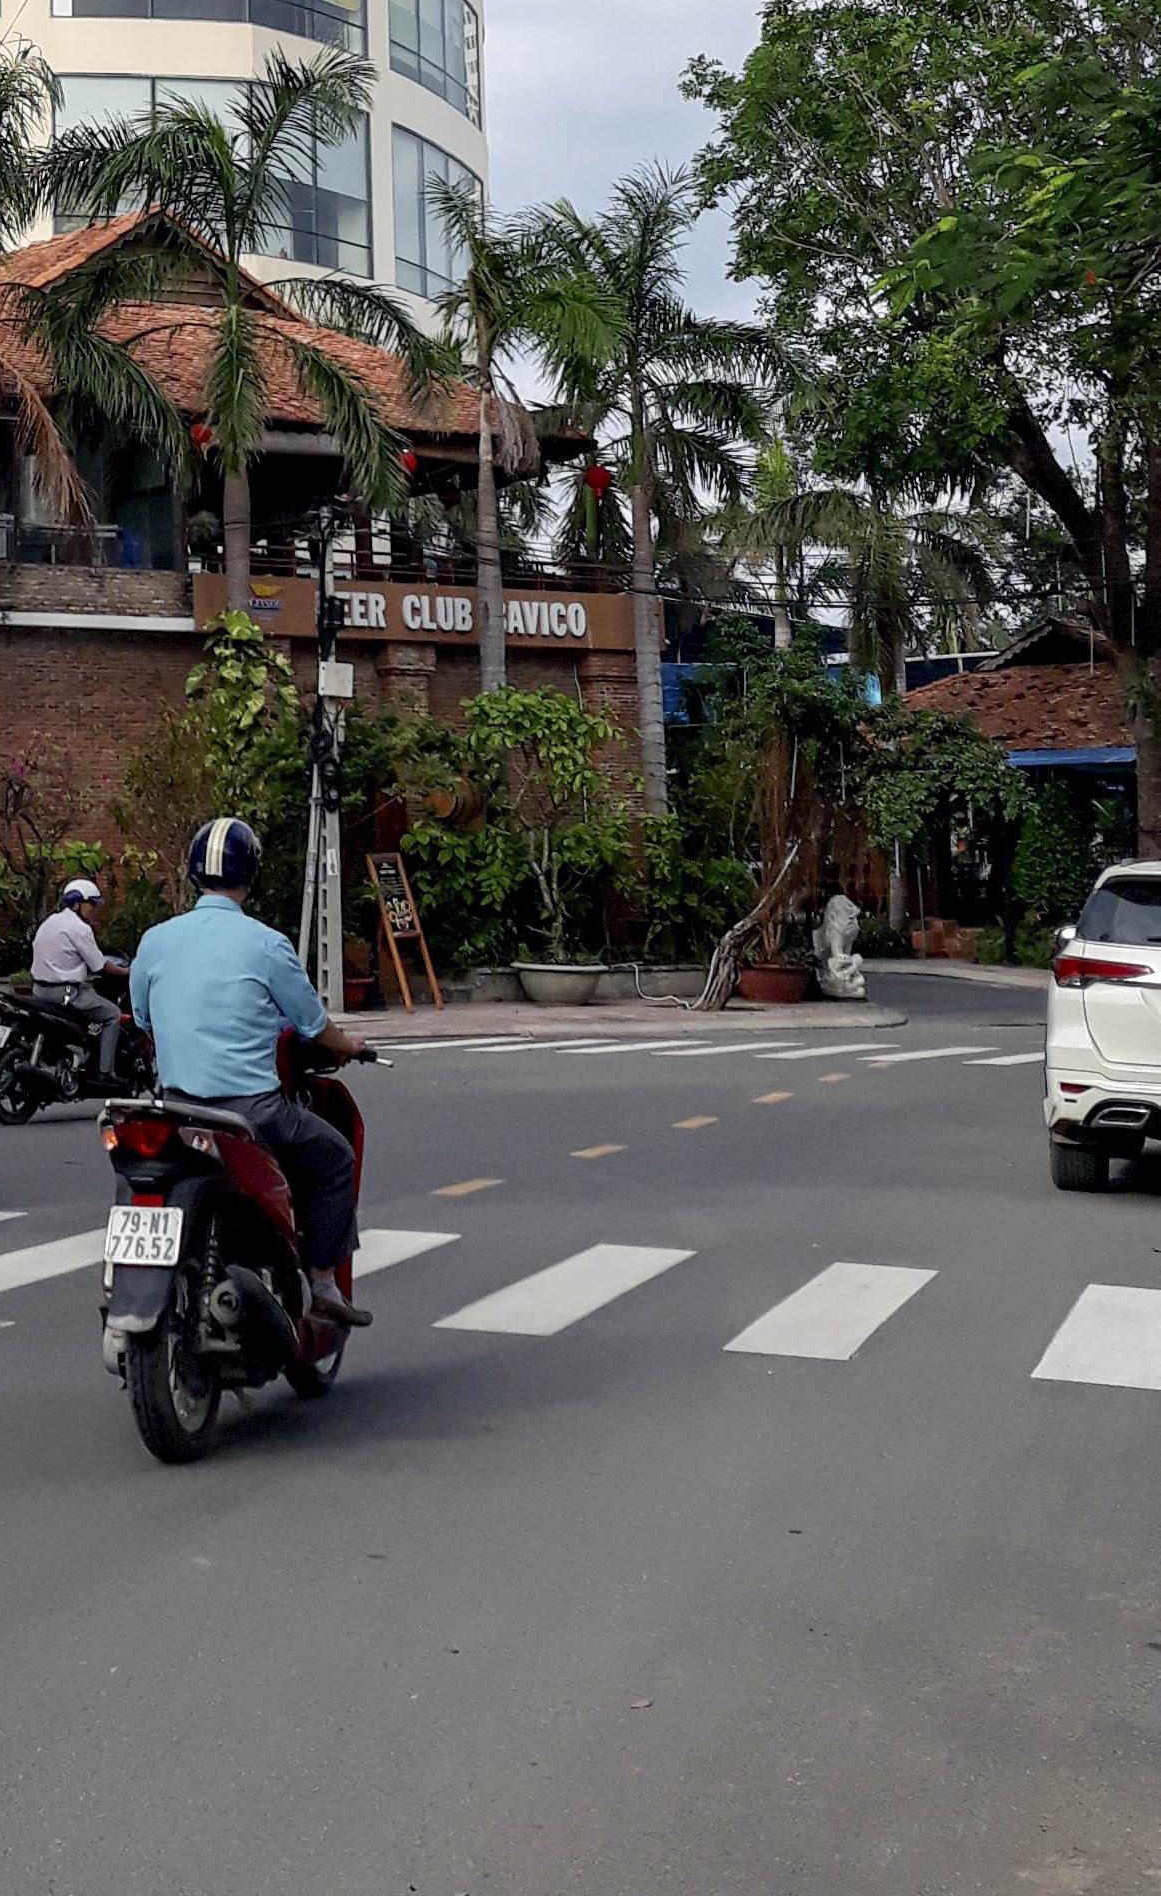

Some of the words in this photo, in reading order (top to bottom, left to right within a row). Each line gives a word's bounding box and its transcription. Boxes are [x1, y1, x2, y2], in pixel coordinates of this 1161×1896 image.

[315, 590, 387, 628] EER
[402, 593, 474, 632] CLUB
[502, 600, 587, 637] AVICO
[120, 1210, 170, 1235] 79-N1
[110, 1235, 175, 1261] 776.52
